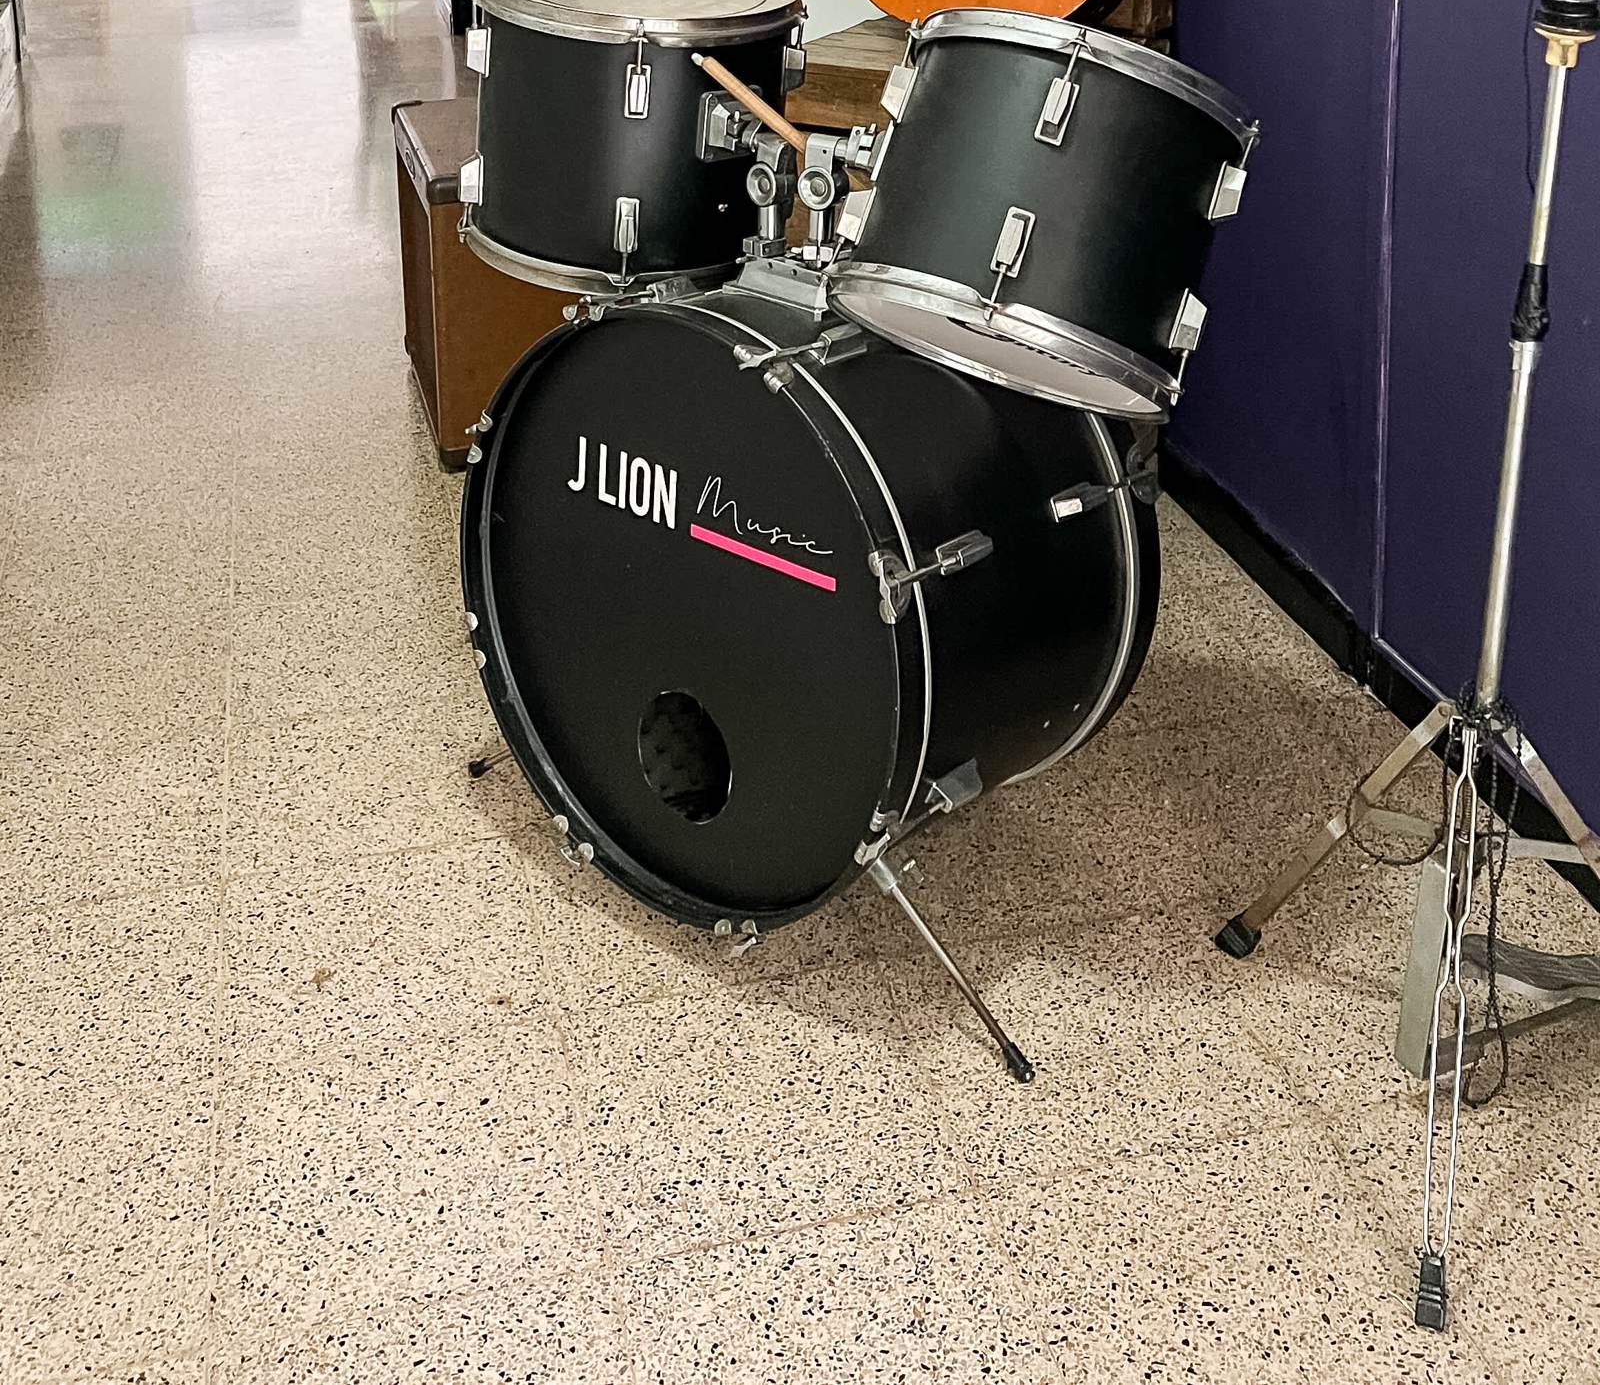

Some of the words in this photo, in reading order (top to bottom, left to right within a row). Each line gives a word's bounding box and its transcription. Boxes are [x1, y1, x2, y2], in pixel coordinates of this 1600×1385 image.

[567, 436, 587, 491] J
[598, 443, 678, 530] LION
[696, 475, 833, 555] Music
